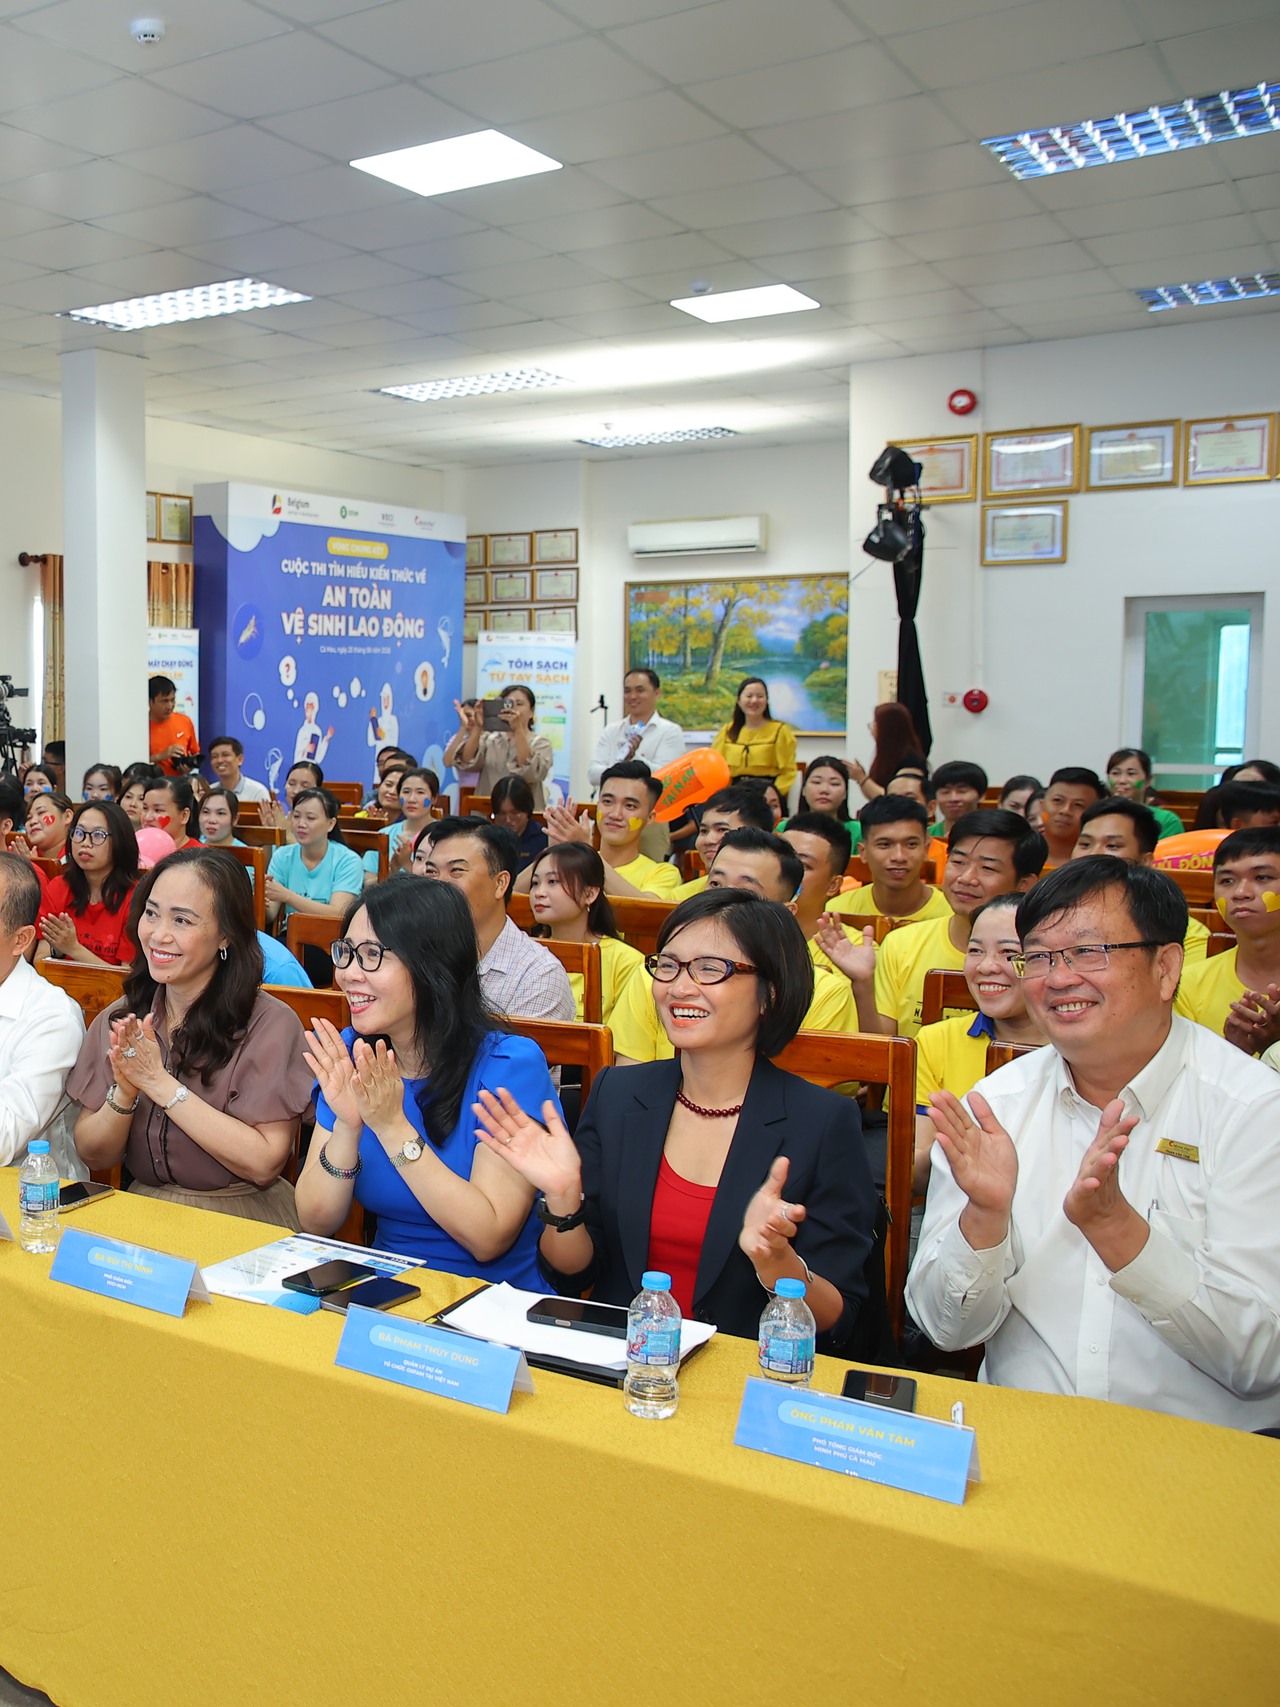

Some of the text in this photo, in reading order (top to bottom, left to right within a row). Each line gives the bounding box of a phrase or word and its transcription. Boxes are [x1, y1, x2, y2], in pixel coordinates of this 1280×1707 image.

[281, 557, 309, 578] CUỘC
[311, 561, 326, 576] THI
[328, 560, 345, 577] TÌM
[369, 563, 390, 581] KIẾN
[322, 582, 392, 610] AN TOÀN
[281, 606, 425, 648] VỆ SINH LAO ĐỘNG
[537, 660, 568, 672] SẠCH
[509, 673, 532, 683] TAY
[536, 674, 570, 686] SẠCH
[103, 1272, 113, 1280] PHÓ
[113, 1275, 124, 1283] GIÁM
[403, 1359, 419, 1368] QUẢN
[434, 1366, 443, 1375] ÁN
[451, 1351, 480, 1367] DUNG
[406, 1367, 425, 1377] OXFAM
[425, 1372, 434, 1381] TẠI
[434, 1374, 446, 1384] VIỆT
[446, 1378, 460, 1387] NAM
[790, 1407, 817, 1422] ÔNG
[859, 1424, 885, 1440] VĂN
[888, 1431, 916, 1448] TÂM
[812, 1437, 883, 1460] PHÓ TỔNG GIÁM ĐỐC
[814, 1446, 876, 1467] MINH PHÚ CÀ MAU
